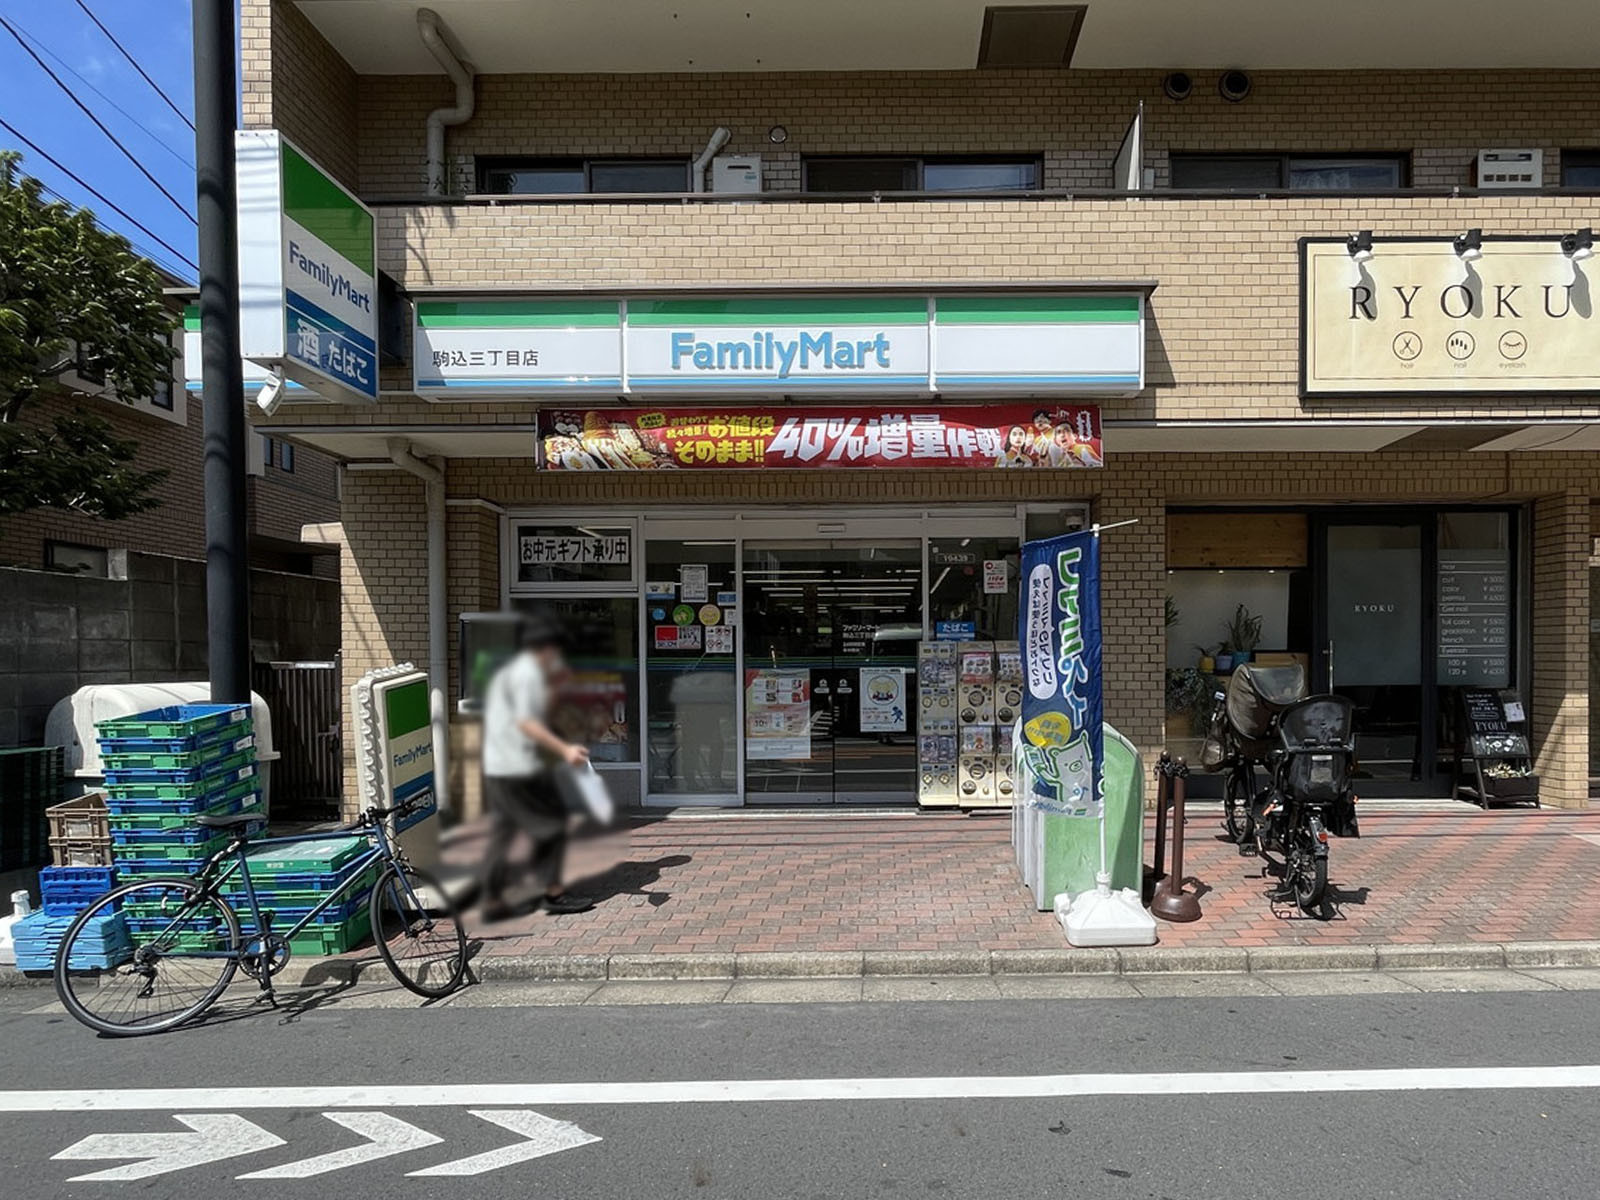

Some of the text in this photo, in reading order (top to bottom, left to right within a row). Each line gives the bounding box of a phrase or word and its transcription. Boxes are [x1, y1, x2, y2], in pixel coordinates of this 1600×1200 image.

[289, 240, 370, 314] FamilyMart
[1349, 285, 1574, 320] RYOKU
[297, 319, 320, 368] 酒
[432, 349, 539, 368] 駒込三丁目店
[671, 331, 891, 379] FamilyMart
[328, 339, 369, 385] たばこ
[708, 414, 776, 438] お値段
[766, 413, 1007, 462] 40%増量作戦
[522, 538, 628, 563] お中元ギフト承り中
[1354, 604, 1395, 613] RYOKU
[943, 623, 969, 633] たばこ
